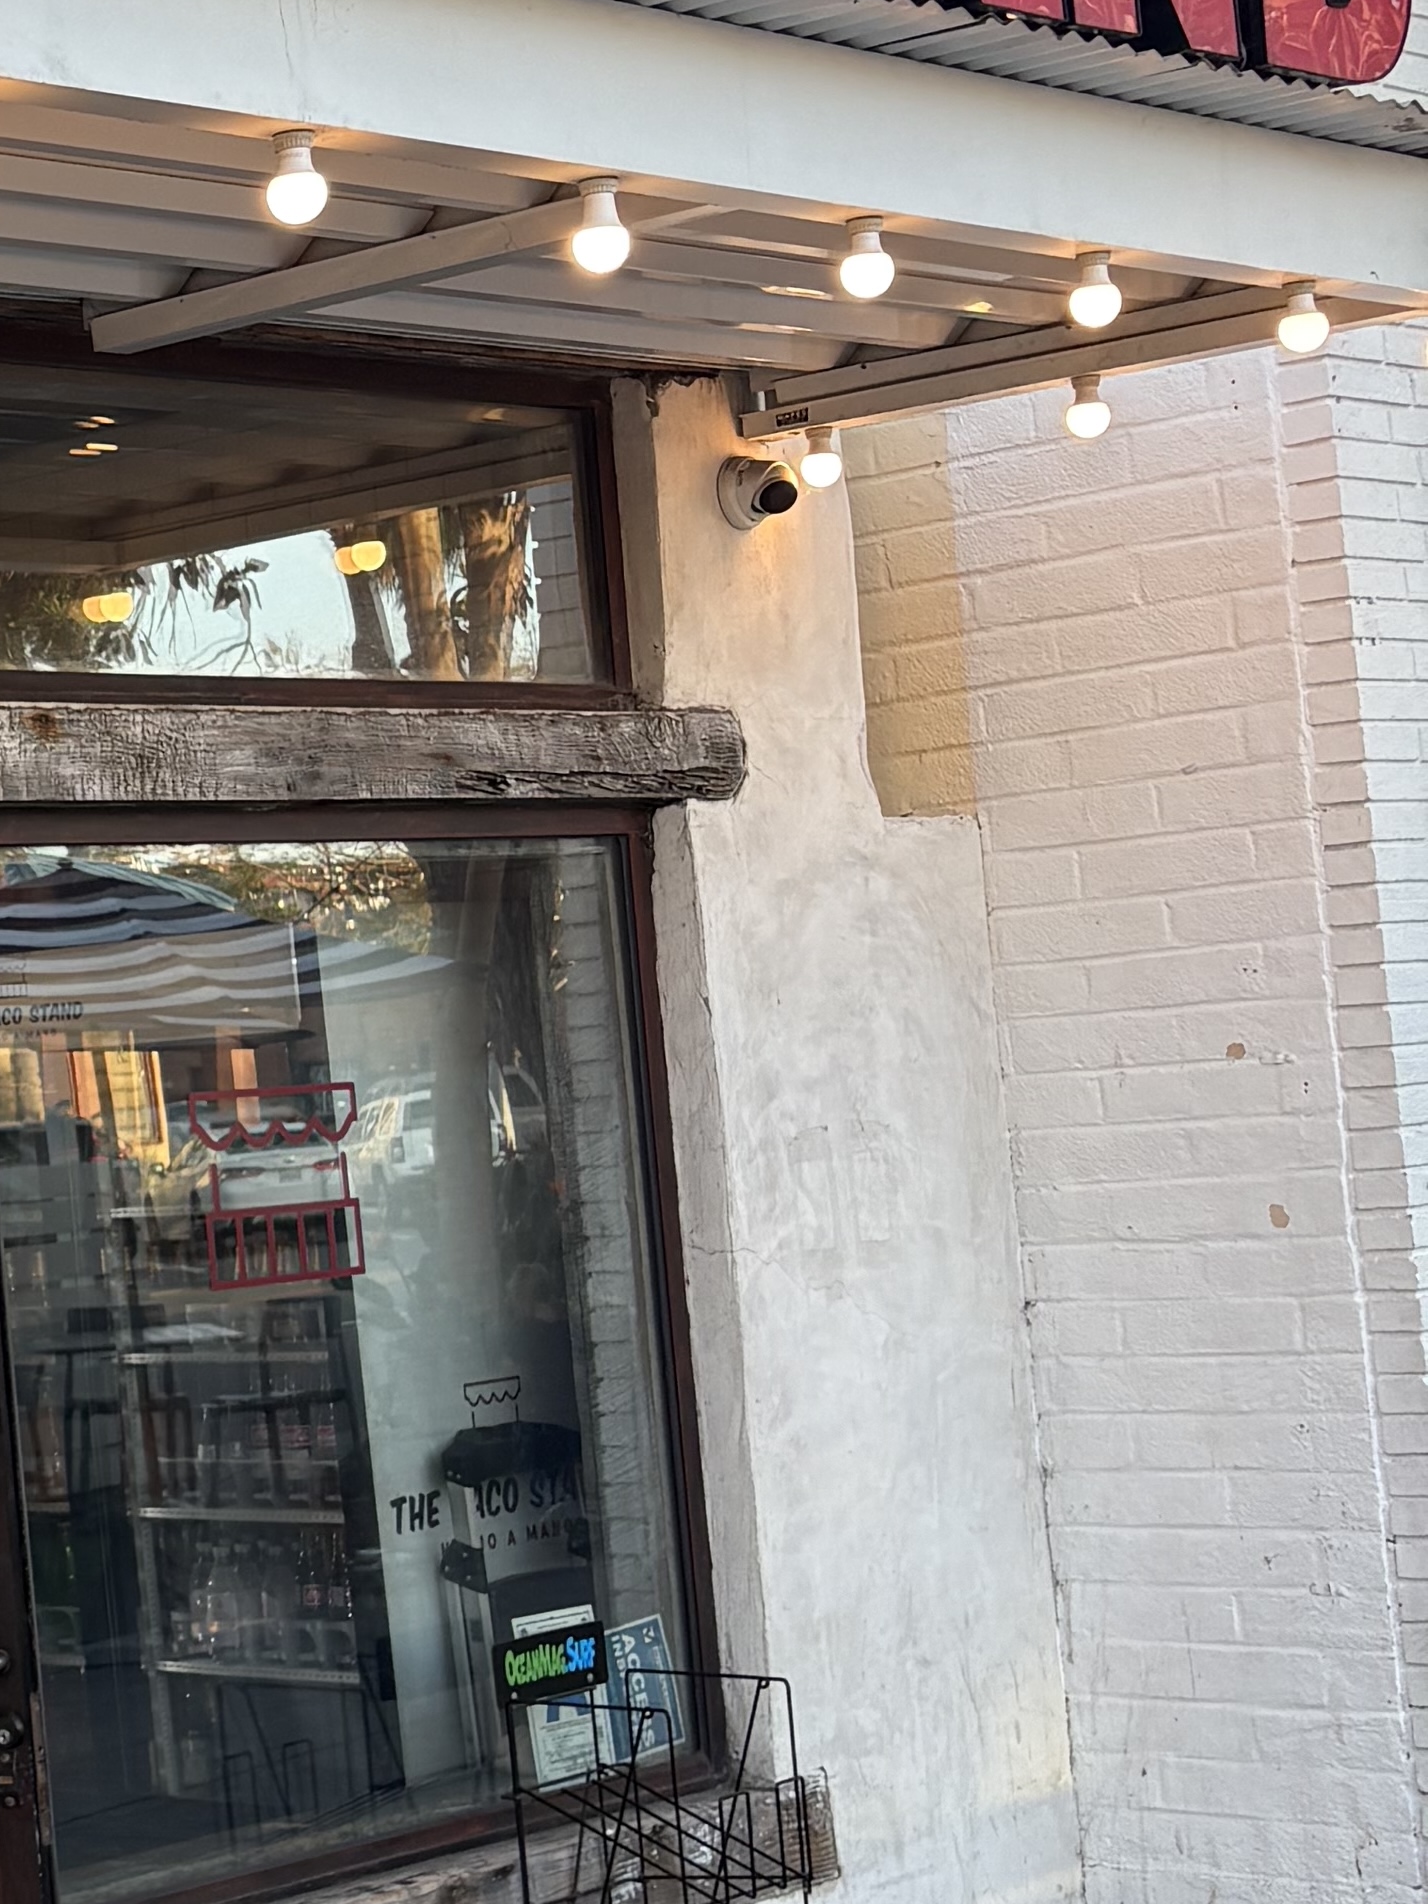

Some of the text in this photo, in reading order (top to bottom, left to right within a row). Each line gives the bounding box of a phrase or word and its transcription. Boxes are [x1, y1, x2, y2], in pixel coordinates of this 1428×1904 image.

[29, 1001, 84, 1023] STAND
[390, 1489, 441, 1535] THE
[474, 1476, 519, 1518] ACO
